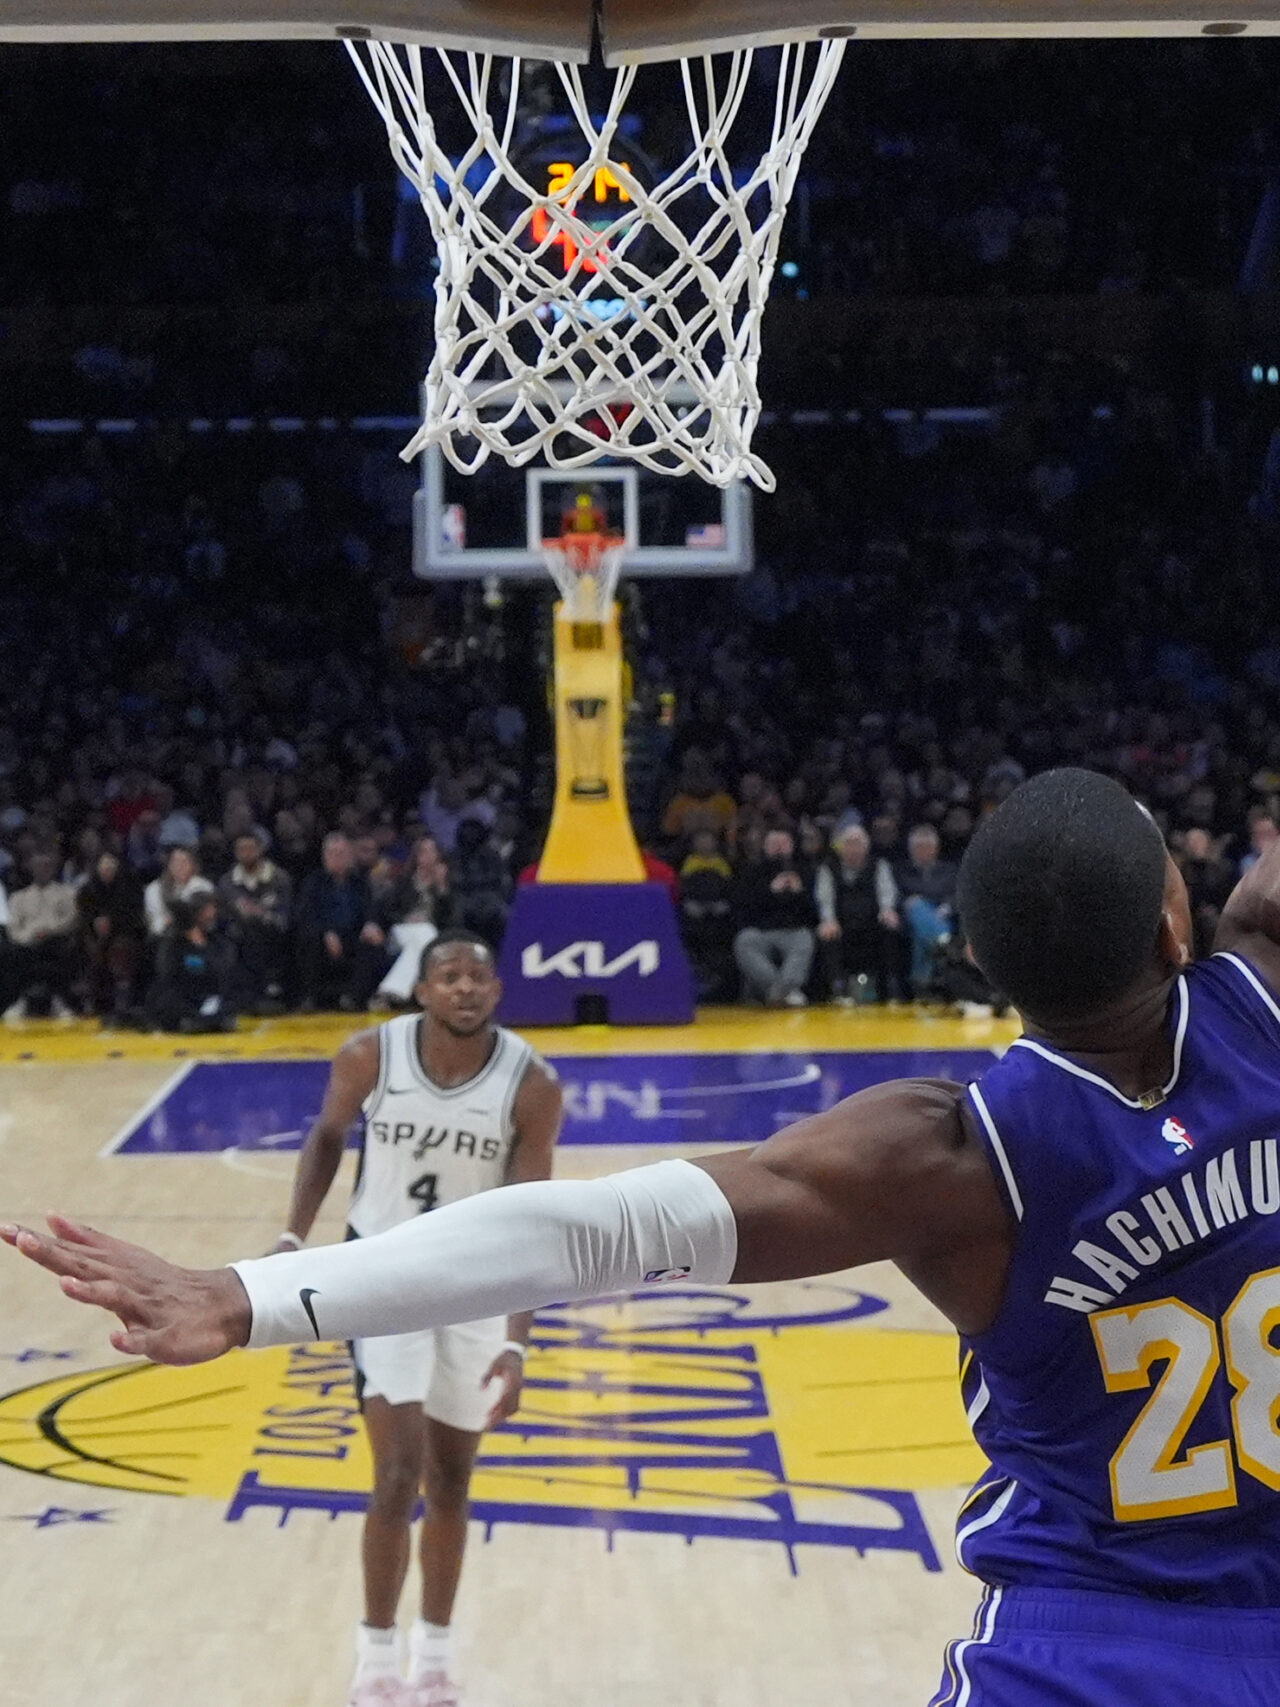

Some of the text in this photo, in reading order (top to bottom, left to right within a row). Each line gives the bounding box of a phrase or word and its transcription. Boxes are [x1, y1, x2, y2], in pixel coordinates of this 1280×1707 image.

[521, 939, 661, 979] KIA
[372, 1121, 500, 1162] SPURS
[408, 1173, 438, 1213] 4
